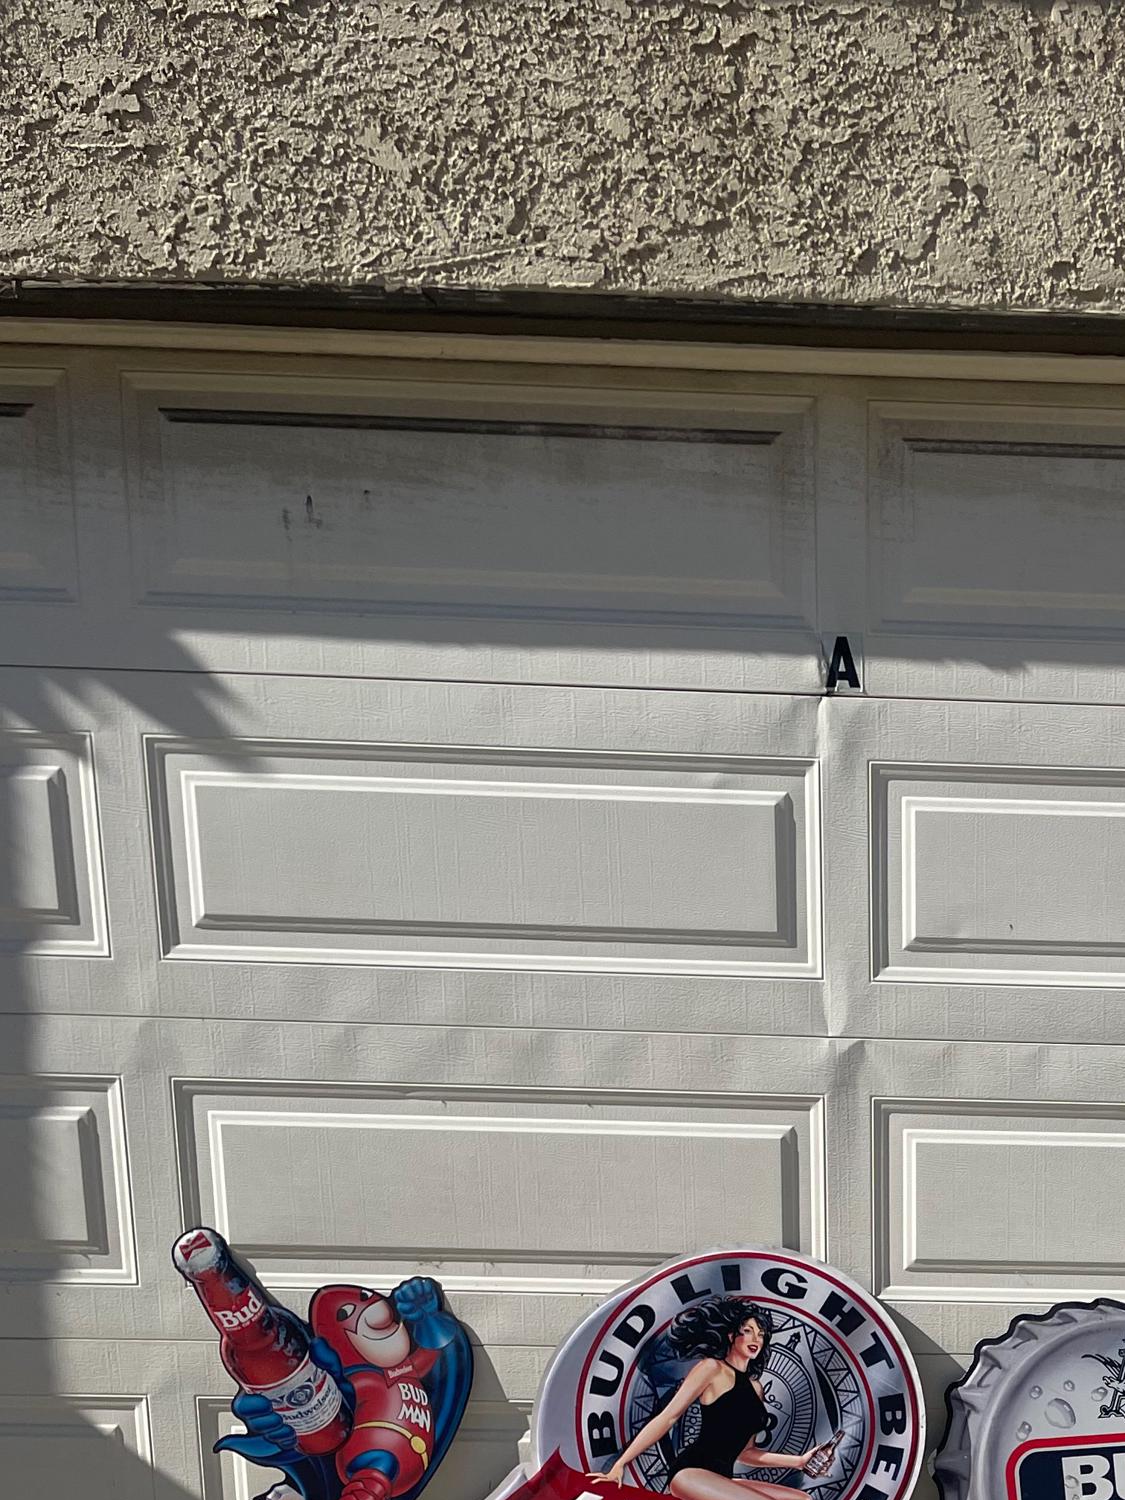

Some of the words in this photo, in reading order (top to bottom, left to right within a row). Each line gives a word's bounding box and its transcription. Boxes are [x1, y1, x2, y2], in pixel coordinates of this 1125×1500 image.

[825, 636, 861, 689] A
[213, 1289, 263, 1328] Bud
[588, 1304, 657, 1459] BUD
[670, 1263, 896, 1382] LIGHT
[398, 1382, 428, 1407] BUD
[398, 1403, 431, 1433] MAN
